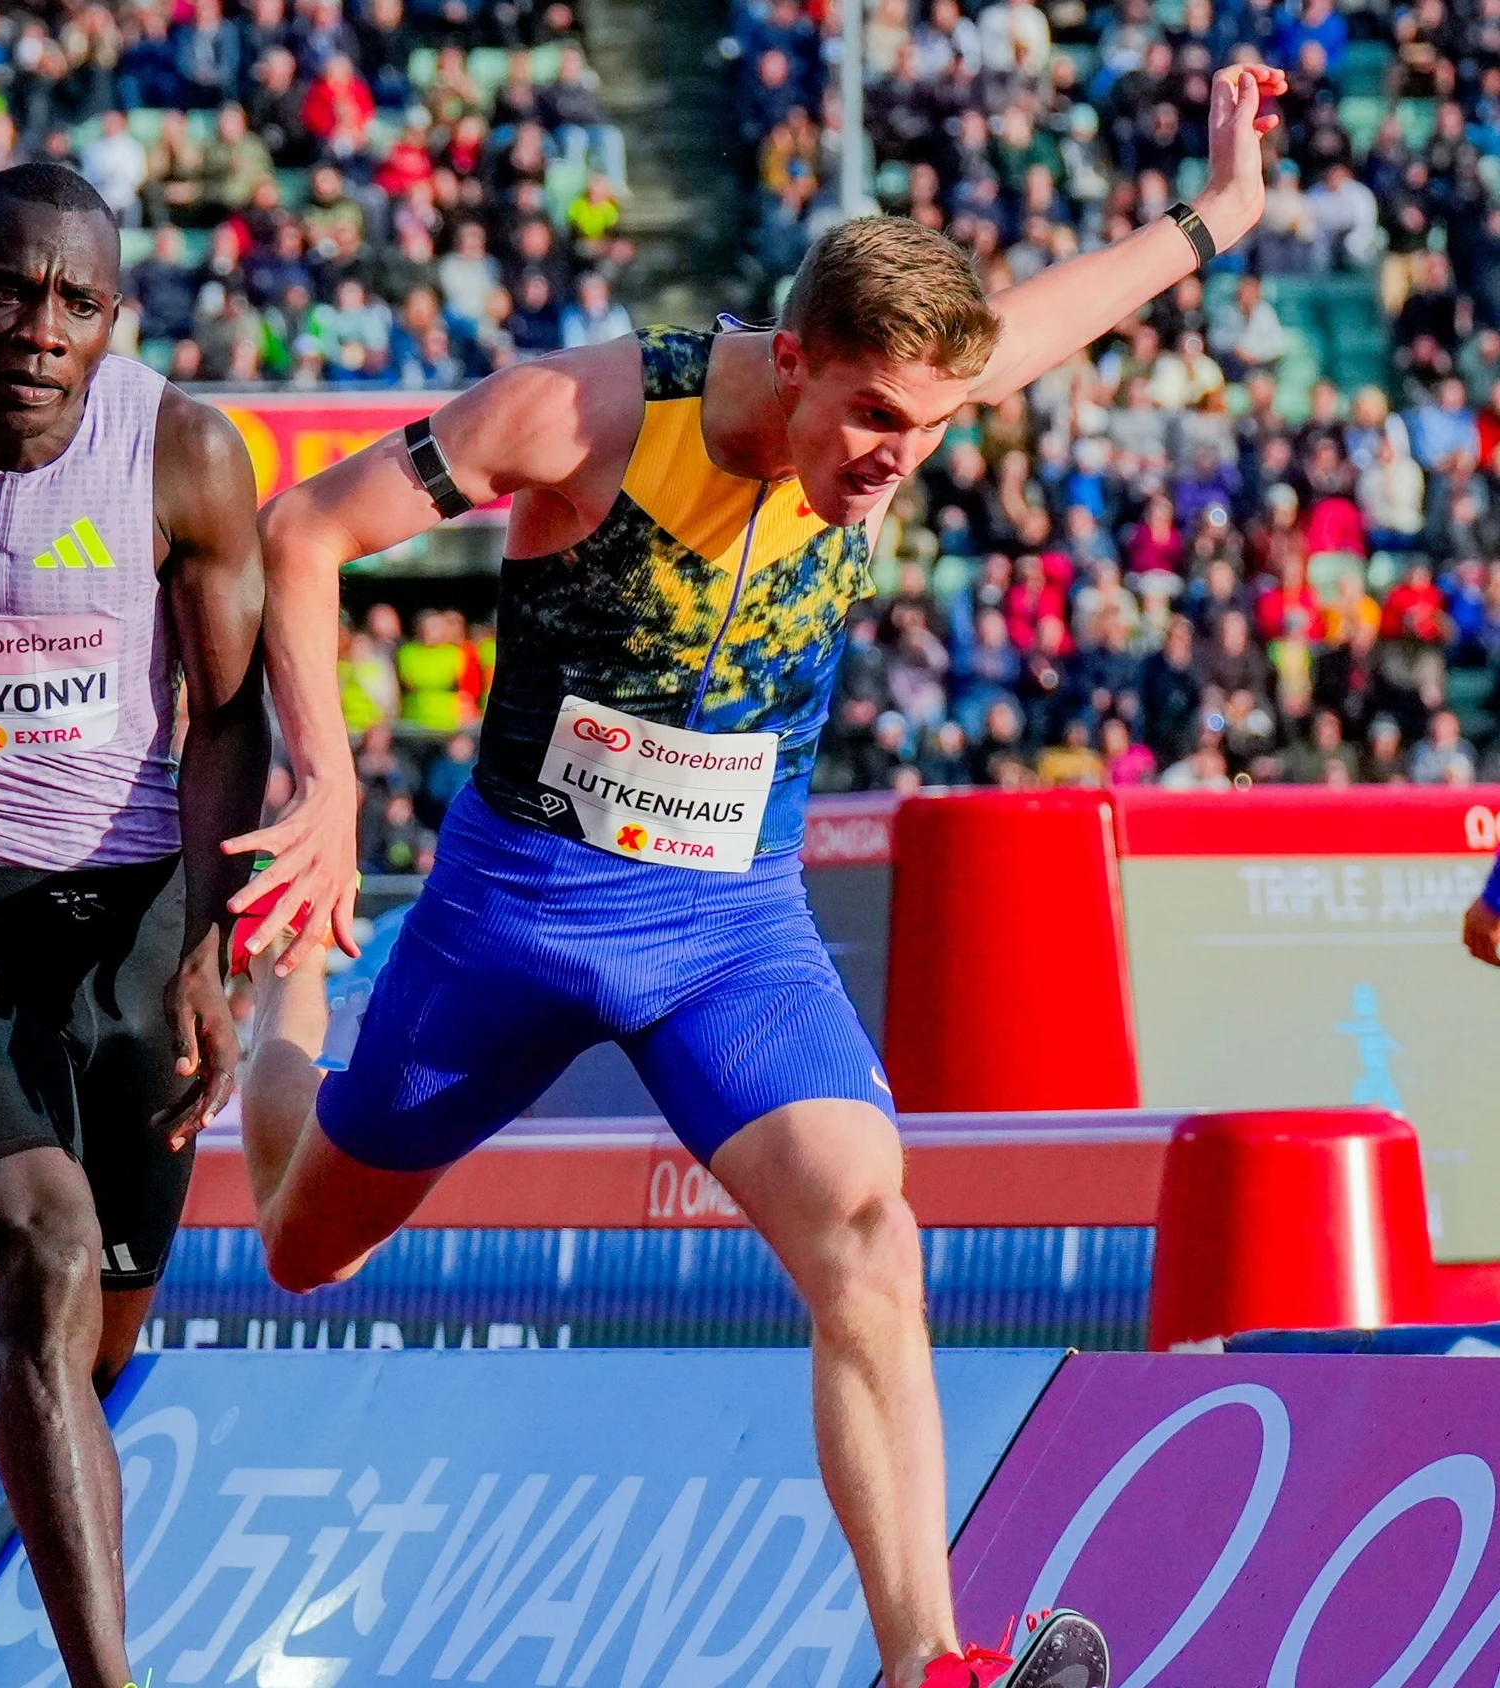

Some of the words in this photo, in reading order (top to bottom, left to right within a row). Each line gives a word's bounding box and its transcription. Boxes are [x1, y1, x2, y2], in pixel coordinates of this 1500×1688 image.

[14, 726, 83, 746] EXTRA
[638, 739, 764, 771] Storebrand
[561, 762, 745, 823] LUTKENHAUS
[653, 837, 715, 859] EXTRA
[1238, 864, 1367, 922] TRIPLE
